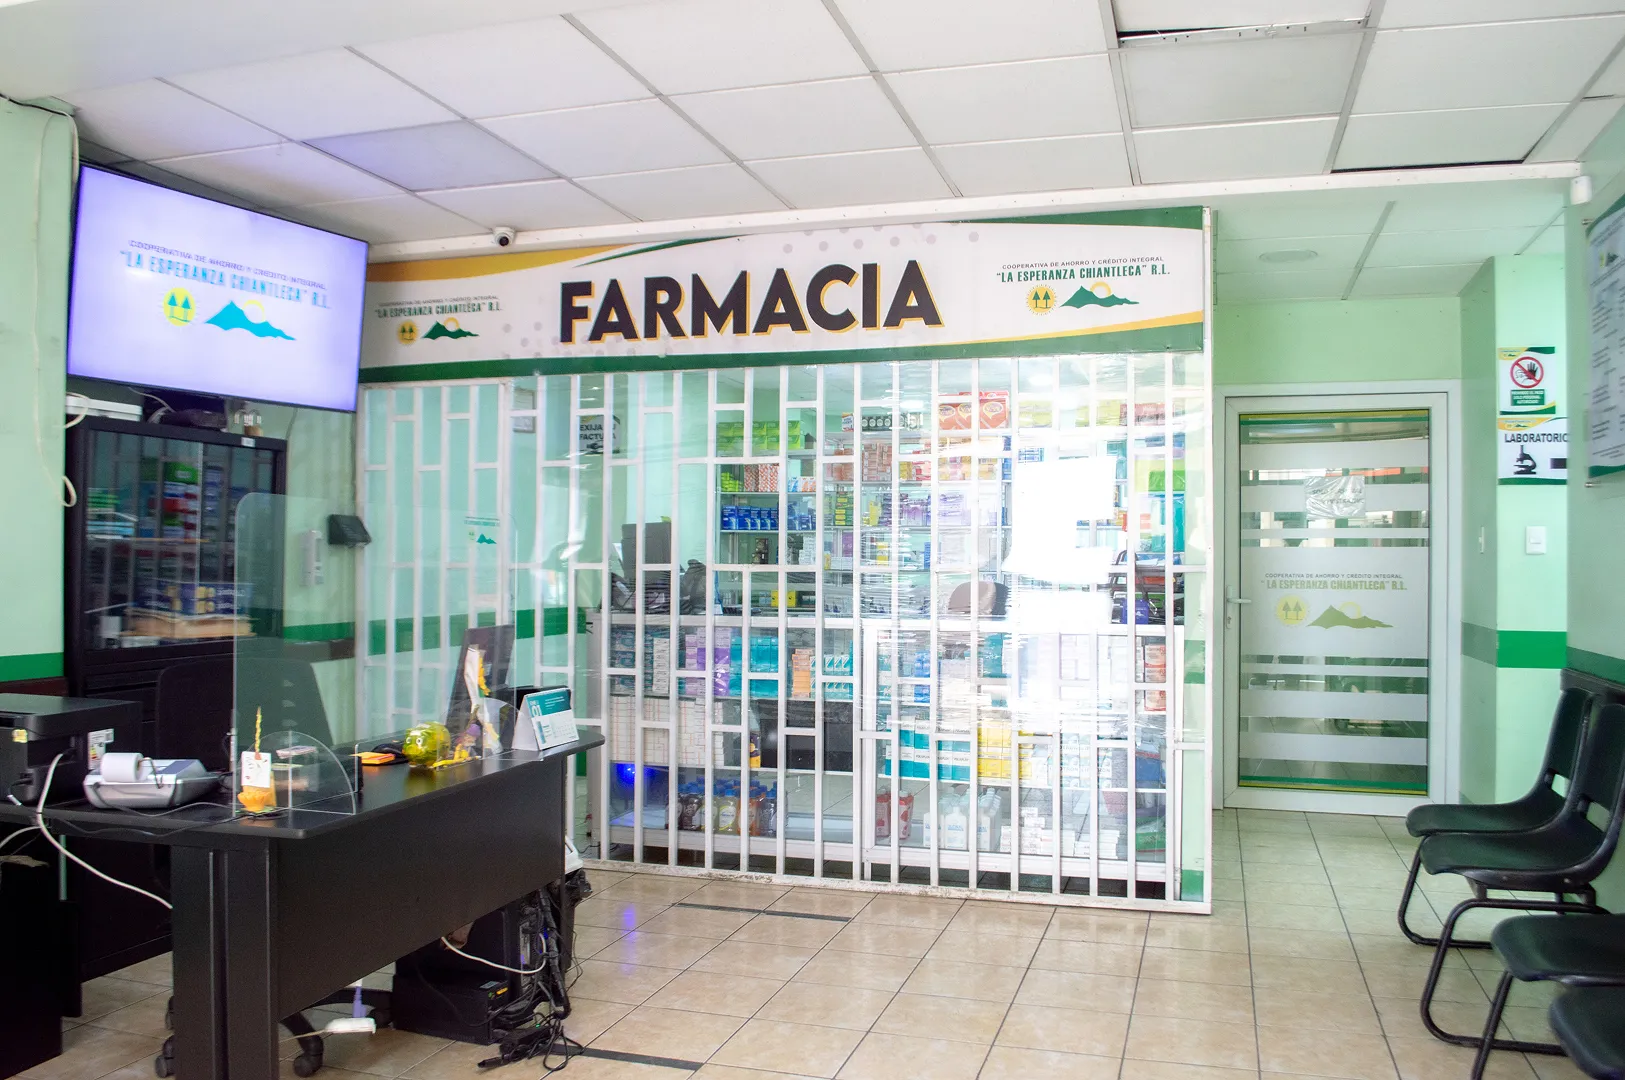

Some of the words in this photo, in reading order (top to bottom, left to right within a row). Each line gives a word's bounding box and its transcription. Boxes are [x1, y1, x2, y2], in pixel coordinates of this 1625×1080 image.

[149, 255, 226, 287] ESPERANZA
[1002, 262, 1048, 270] COOPERATIVA
[1097, 257, 1128, 265] CRÉDITO
[1018, 268, 1075, 282] ESPERANZA
[1151, 264, 1171, 275] R.L.
[560, 259, 944, 345] FARMACIA
[390, 305, 433, 318] ESPERANZA
[1279, 580, 1328, 590] ESPERANZA
